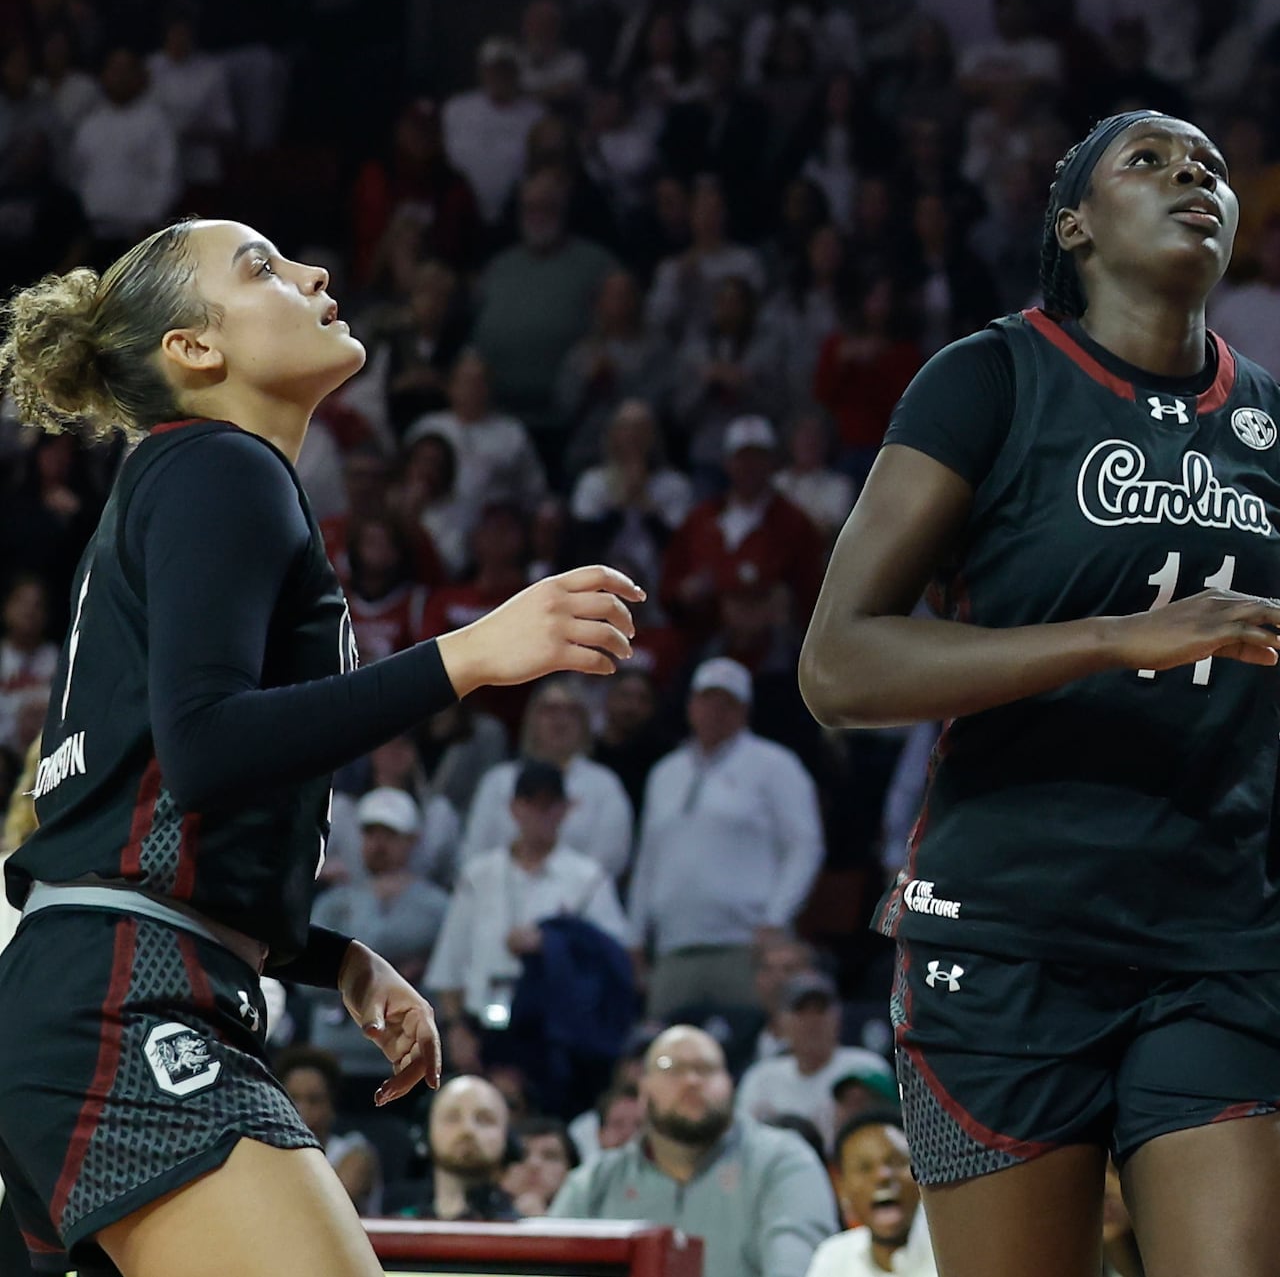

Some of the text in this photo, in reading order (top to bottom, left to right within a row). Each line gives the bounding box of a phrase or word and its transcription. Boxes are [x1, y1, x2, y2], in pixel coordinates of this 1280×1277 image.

[1234, 410, 1275, 446] SEC
[1077, 439, 1273, 537] Carolina
[916, 880, 935, 898] THE
[912, 896, 962, 920] CULTURE
